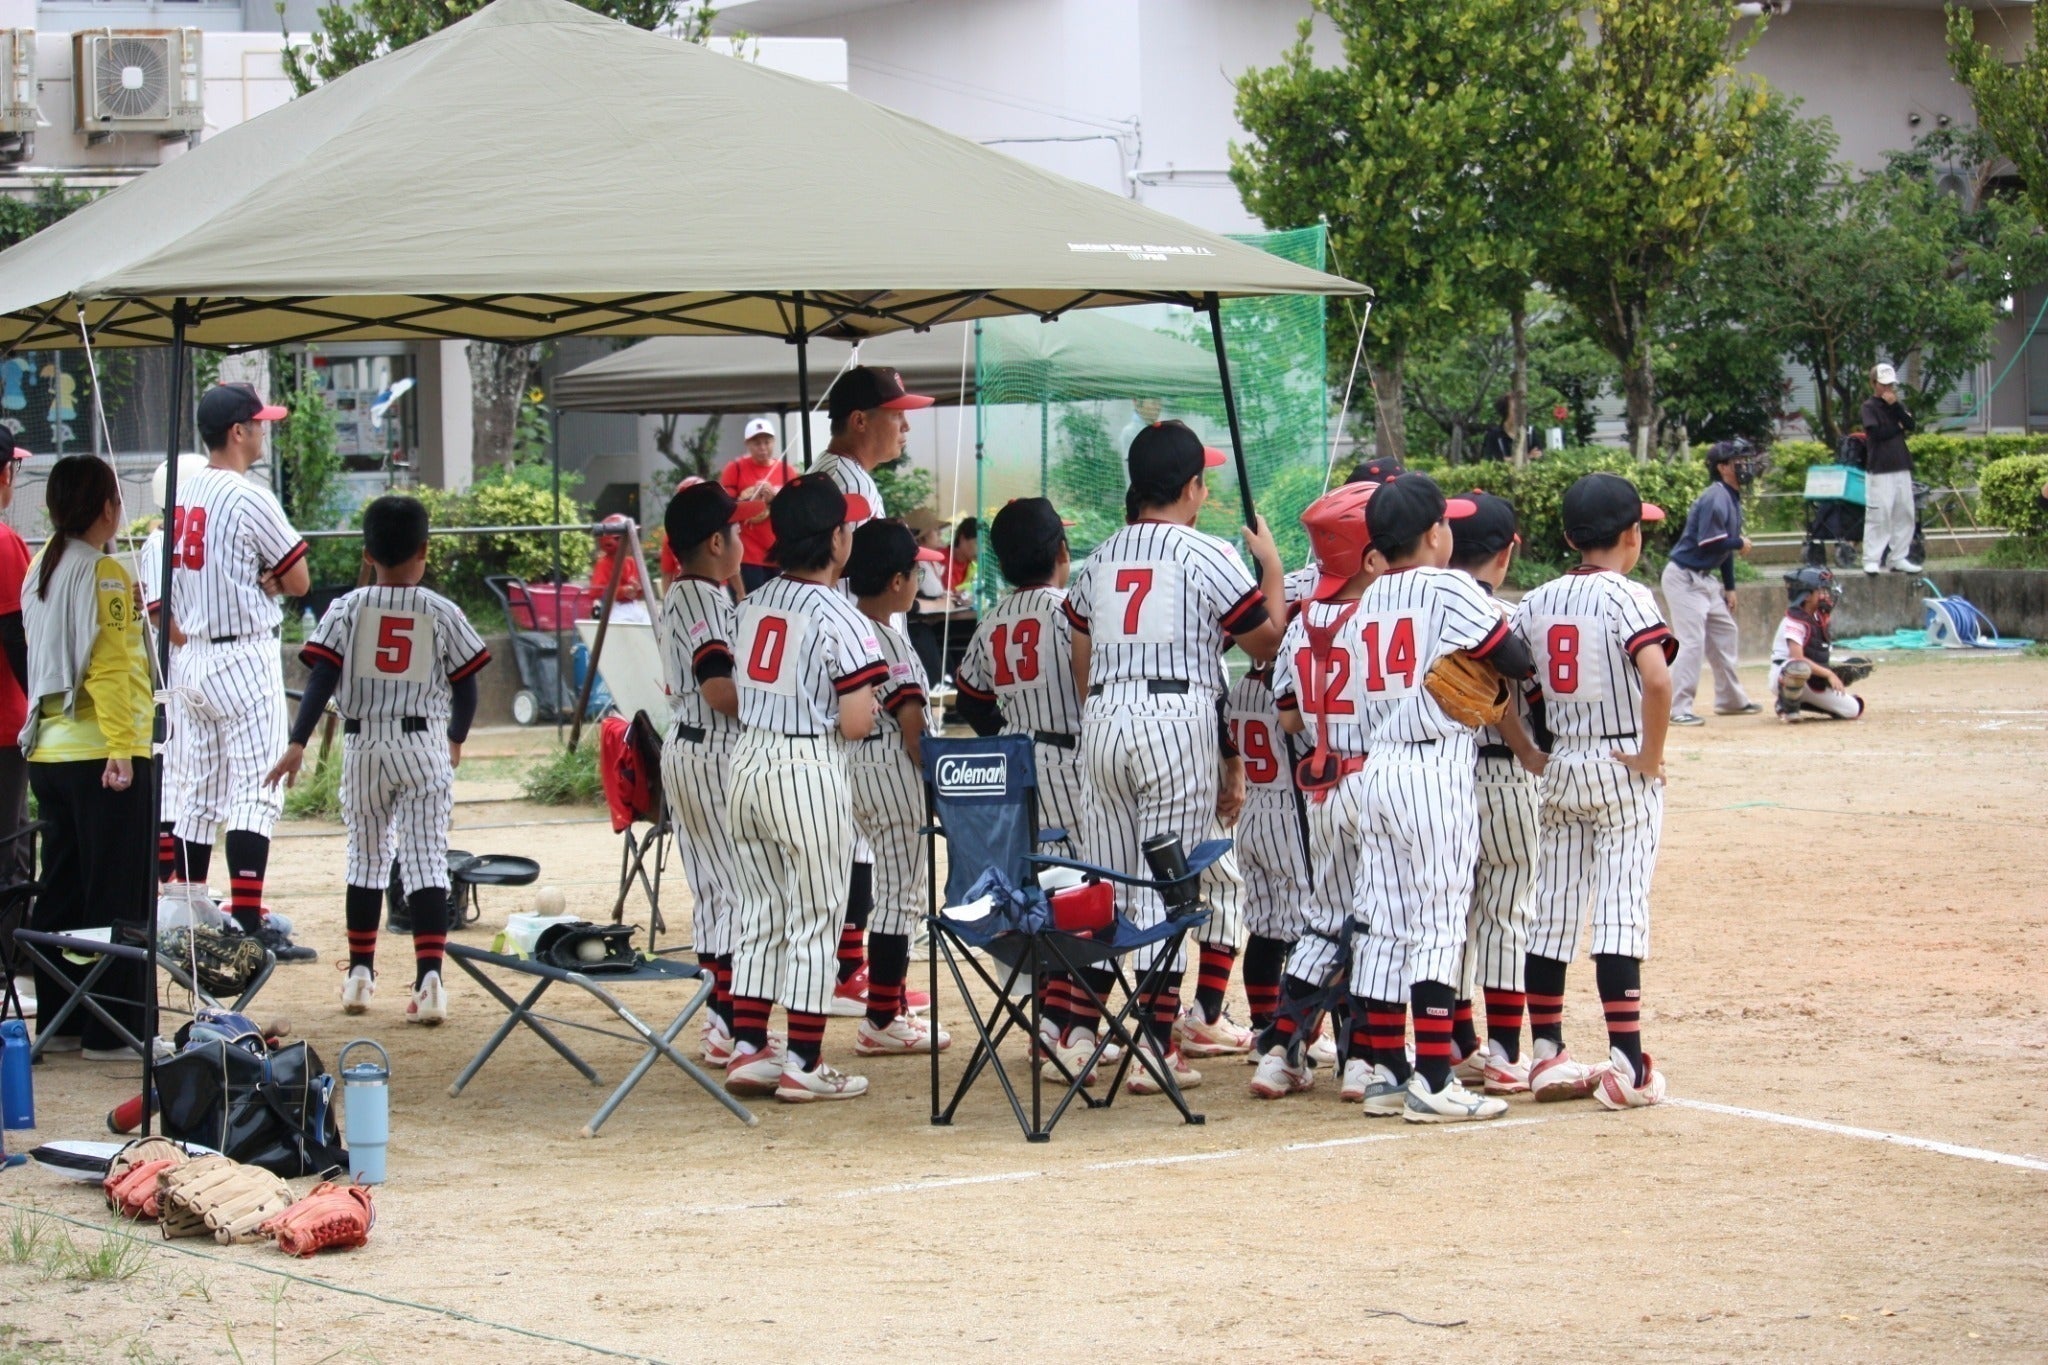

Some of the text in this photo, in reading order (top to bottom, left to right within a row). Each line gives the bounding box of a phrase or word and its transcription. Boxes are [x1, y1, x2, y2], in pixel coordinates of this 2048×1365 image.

[171, 505, 207, 571] 28
[1115, 568, 1153, 635] 7
[375, 615, 414, 674] 5
[747, 614, 788, 684] 0
[989, 618, 1041, 686] 13
[1361, 617, 1417, 692] 14
[1547, 623, 1579, 694] 8
[1294, 646, 1355, 714] 12
[940, 759, 1006, 786] Coleman
